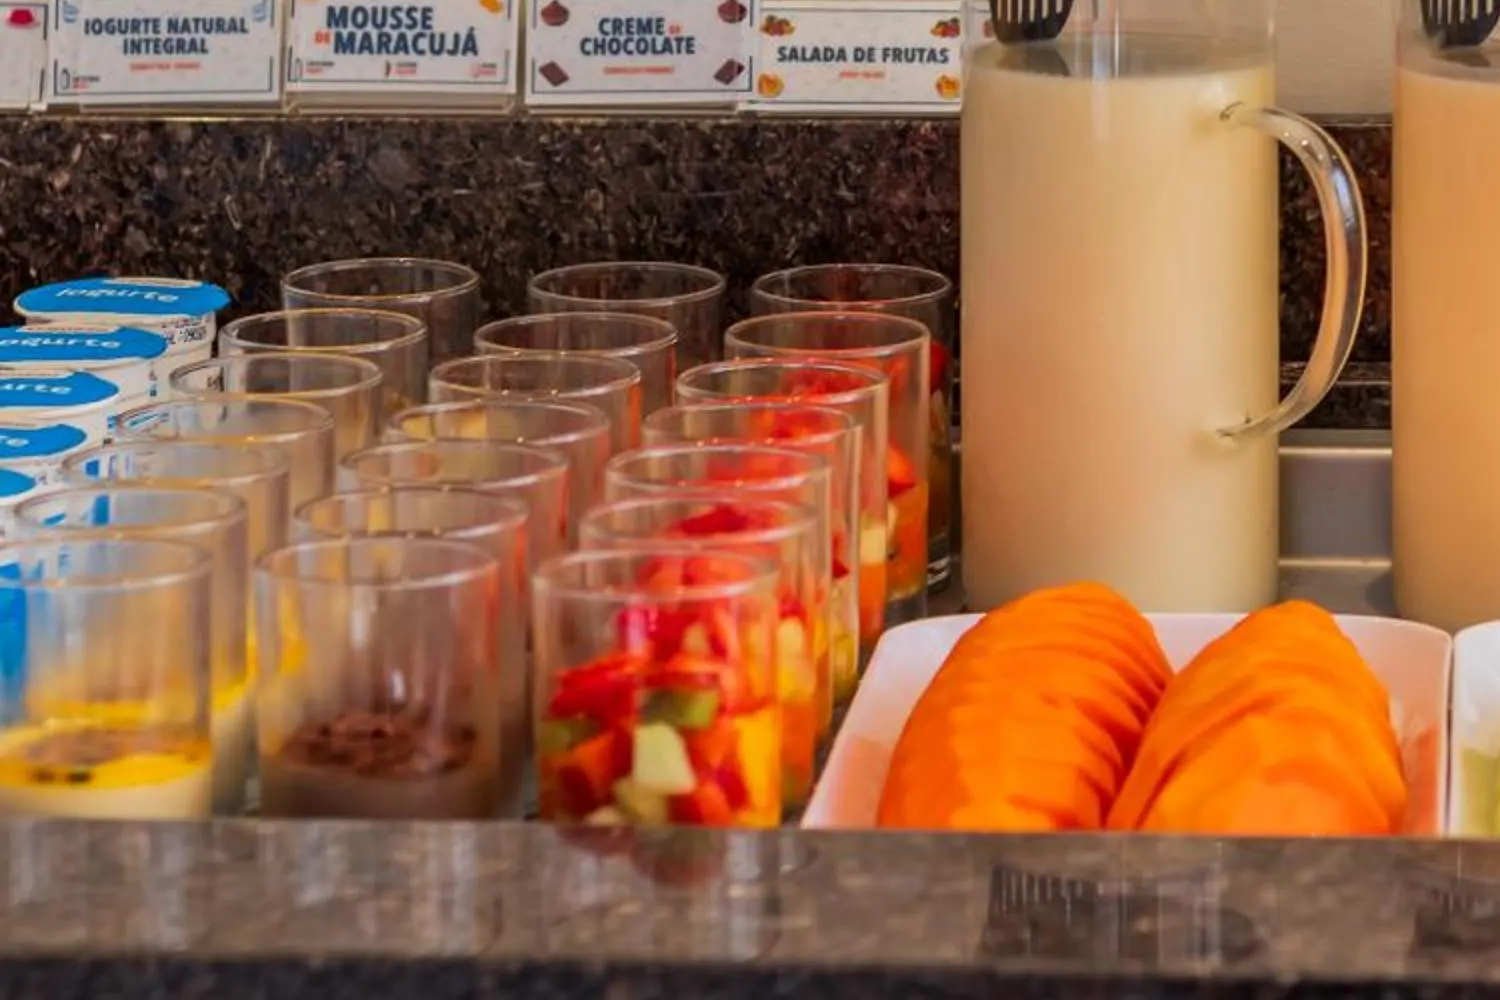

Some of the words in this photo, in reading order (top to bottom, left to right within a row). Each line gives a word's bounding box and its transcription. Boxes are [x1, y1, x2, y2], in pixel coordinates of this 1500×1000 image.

[84, 17, 161, 36] IOGURTE
[166, 16, 249, 35] NATURAL
[325, 5, 434, 31] MOUSSE
[598, 16, 666, 37] CREME
[122, 36, 209, 56] INTEGRAL
[333, 25, 479, 57] MARACUJÁ
[579, 35, 696, 57] CHOCOLATE
[777, 45, 848, 63] SALADA
[853, 46, 876, 63] DE
[881, 46, 950, 65] FRUTAS
